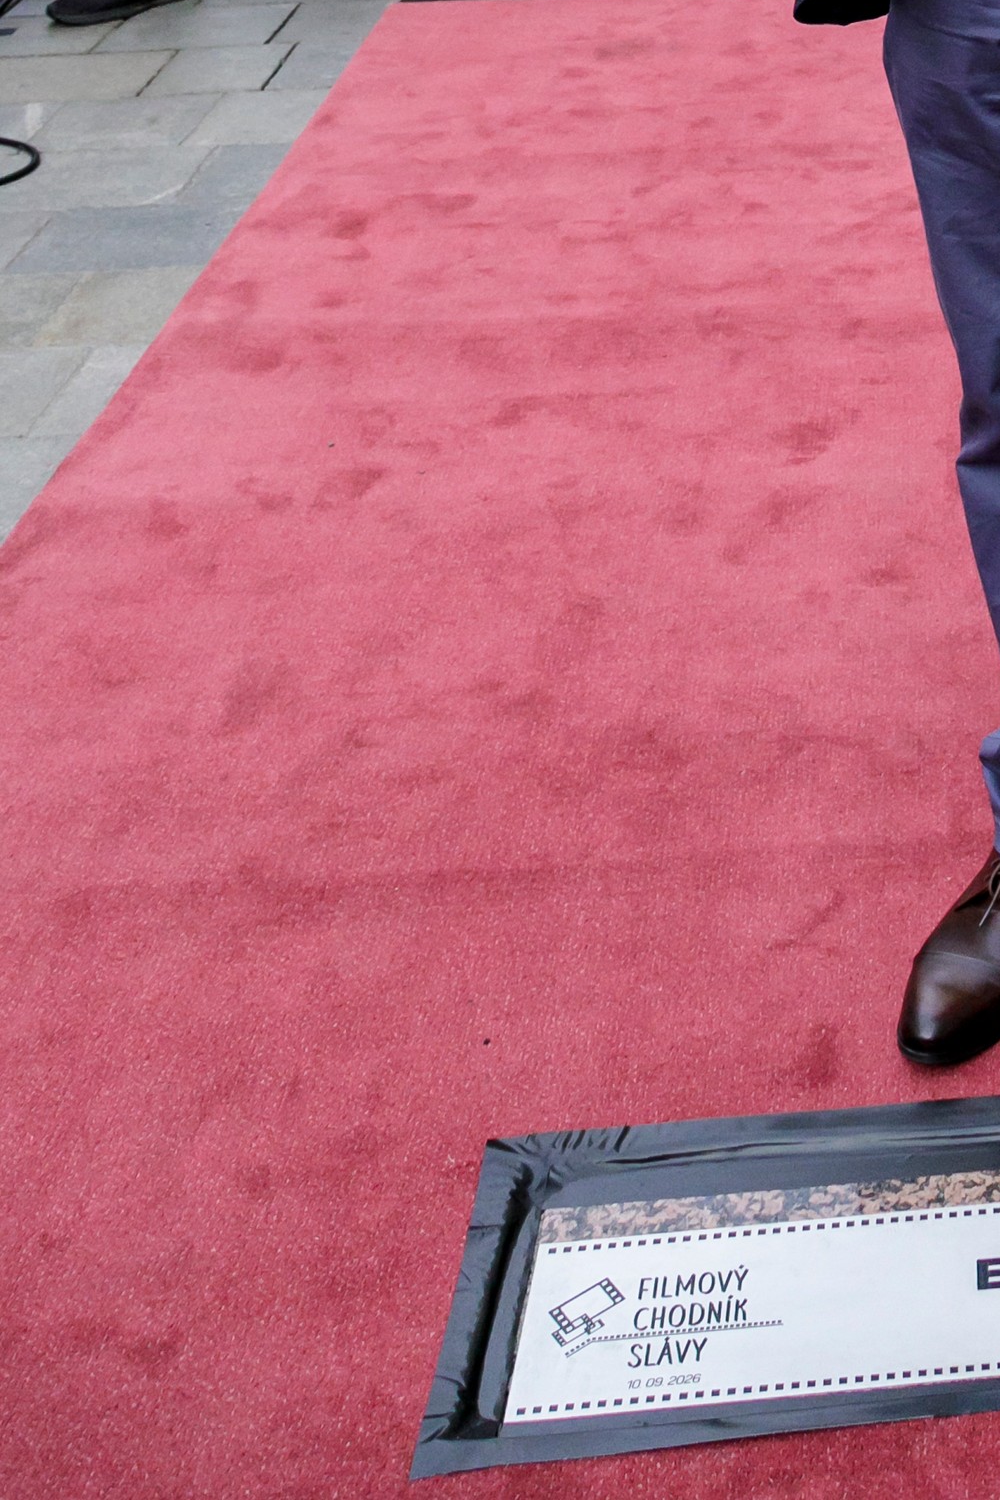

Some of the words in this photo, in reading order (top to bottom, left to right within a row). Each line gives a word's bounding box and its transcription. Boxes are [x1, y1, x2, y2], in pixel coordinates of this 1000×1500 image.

[638, 1264, 749, 1300] FILMOVÝ
[633, 1295, 748, 1331] CHODNÍK
[627, 1336, 708, 1368] SLÁVY
[667, 1373, 702, 1386] 2026
